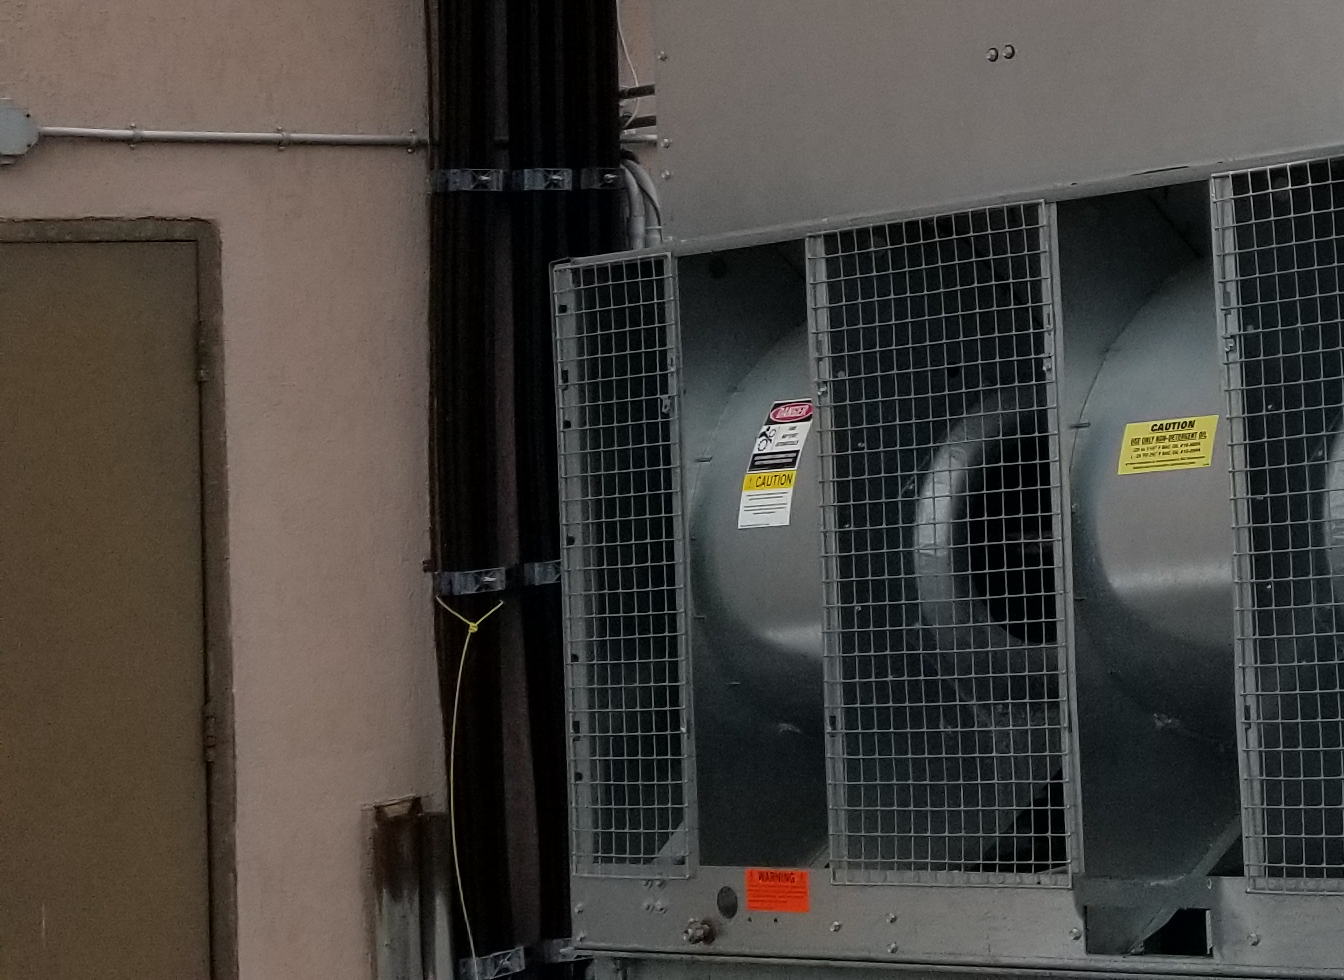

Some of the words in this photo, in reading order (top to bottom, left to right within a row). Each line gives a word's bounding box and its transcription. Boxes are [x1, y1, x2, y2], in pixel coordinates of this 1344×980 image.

[1150, 420, 1196, 432] CAUTION
[755, 473, 793, 488] CAUTION
[758, 871, 795, 884] WARNING
